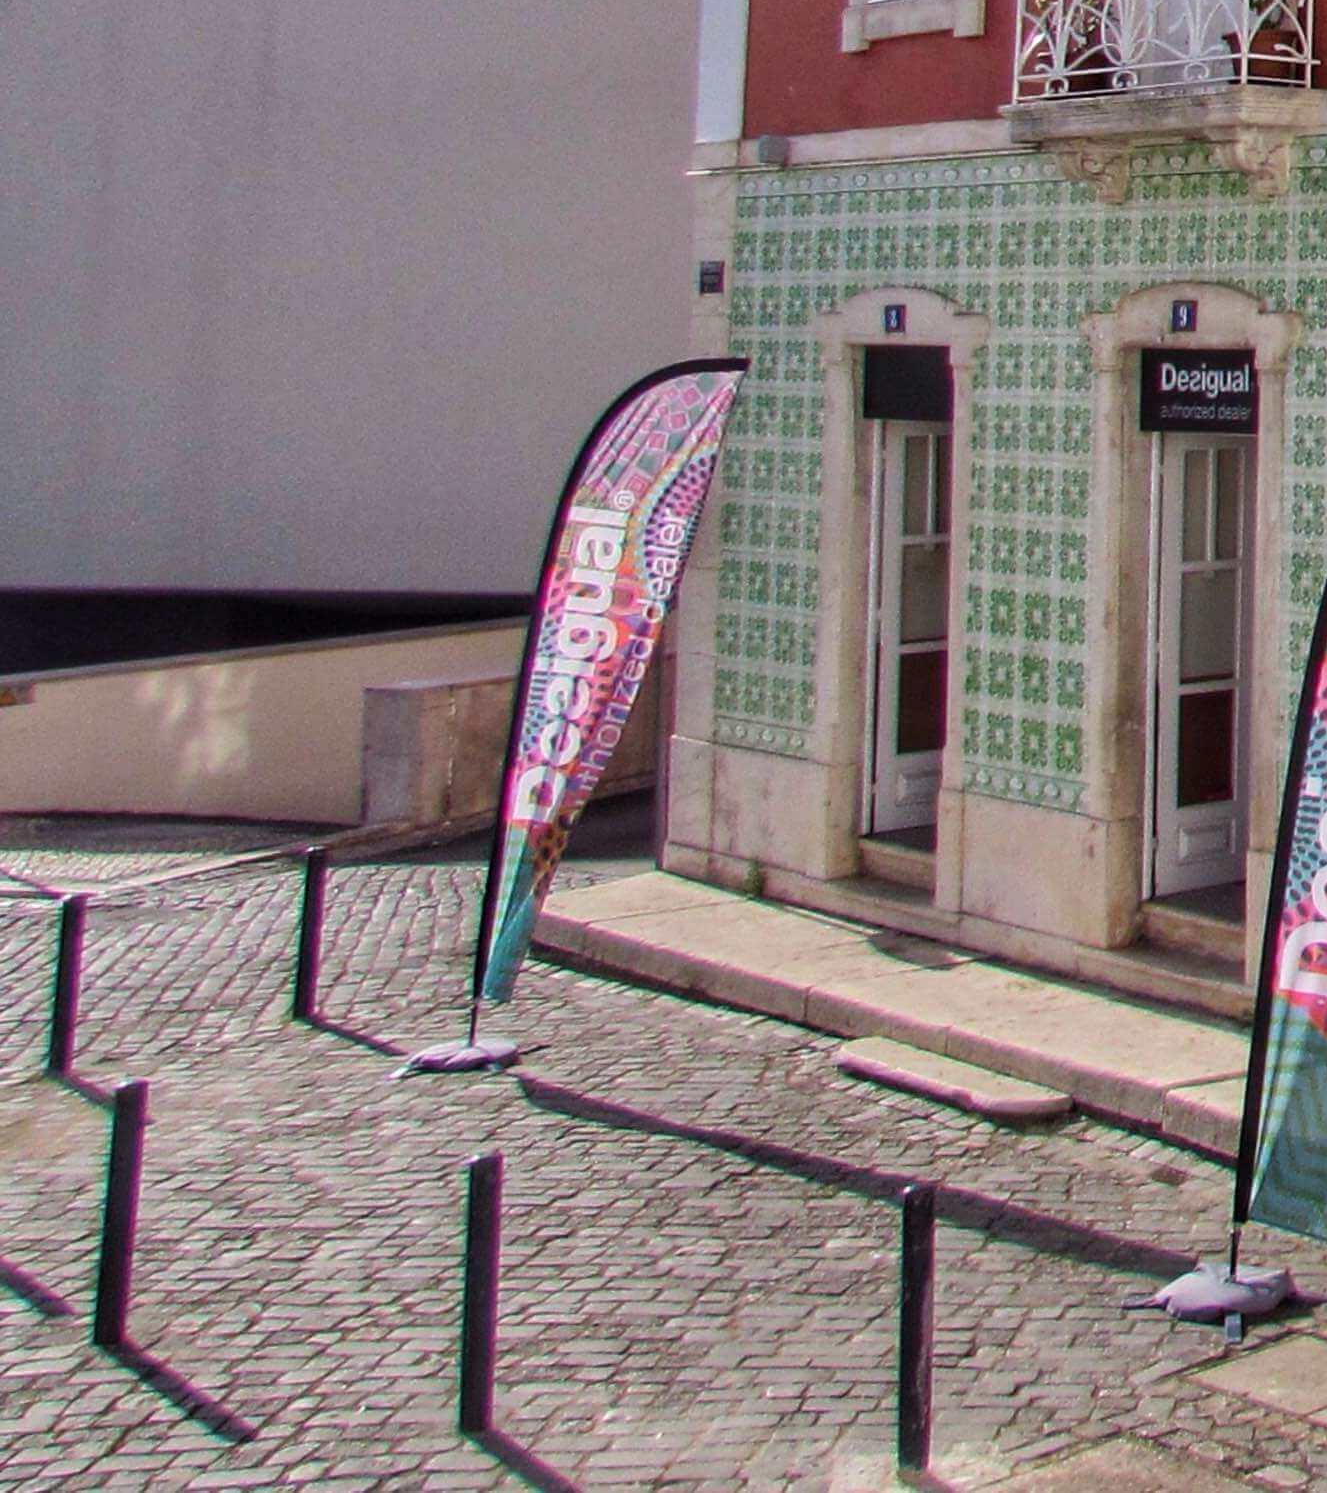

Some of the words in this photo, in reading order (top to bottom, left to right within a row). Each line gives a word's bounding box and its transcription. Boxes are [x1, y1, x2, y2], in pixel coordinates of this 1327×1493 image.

[1179, 305, 1188, 327] 9
[1160, 363, 1250, 398] Desigual
[1160, 403, 1216, 419] authorized
[1217, 404, 1251, 420] dealer
[636, 508, 688, 623] dealer
